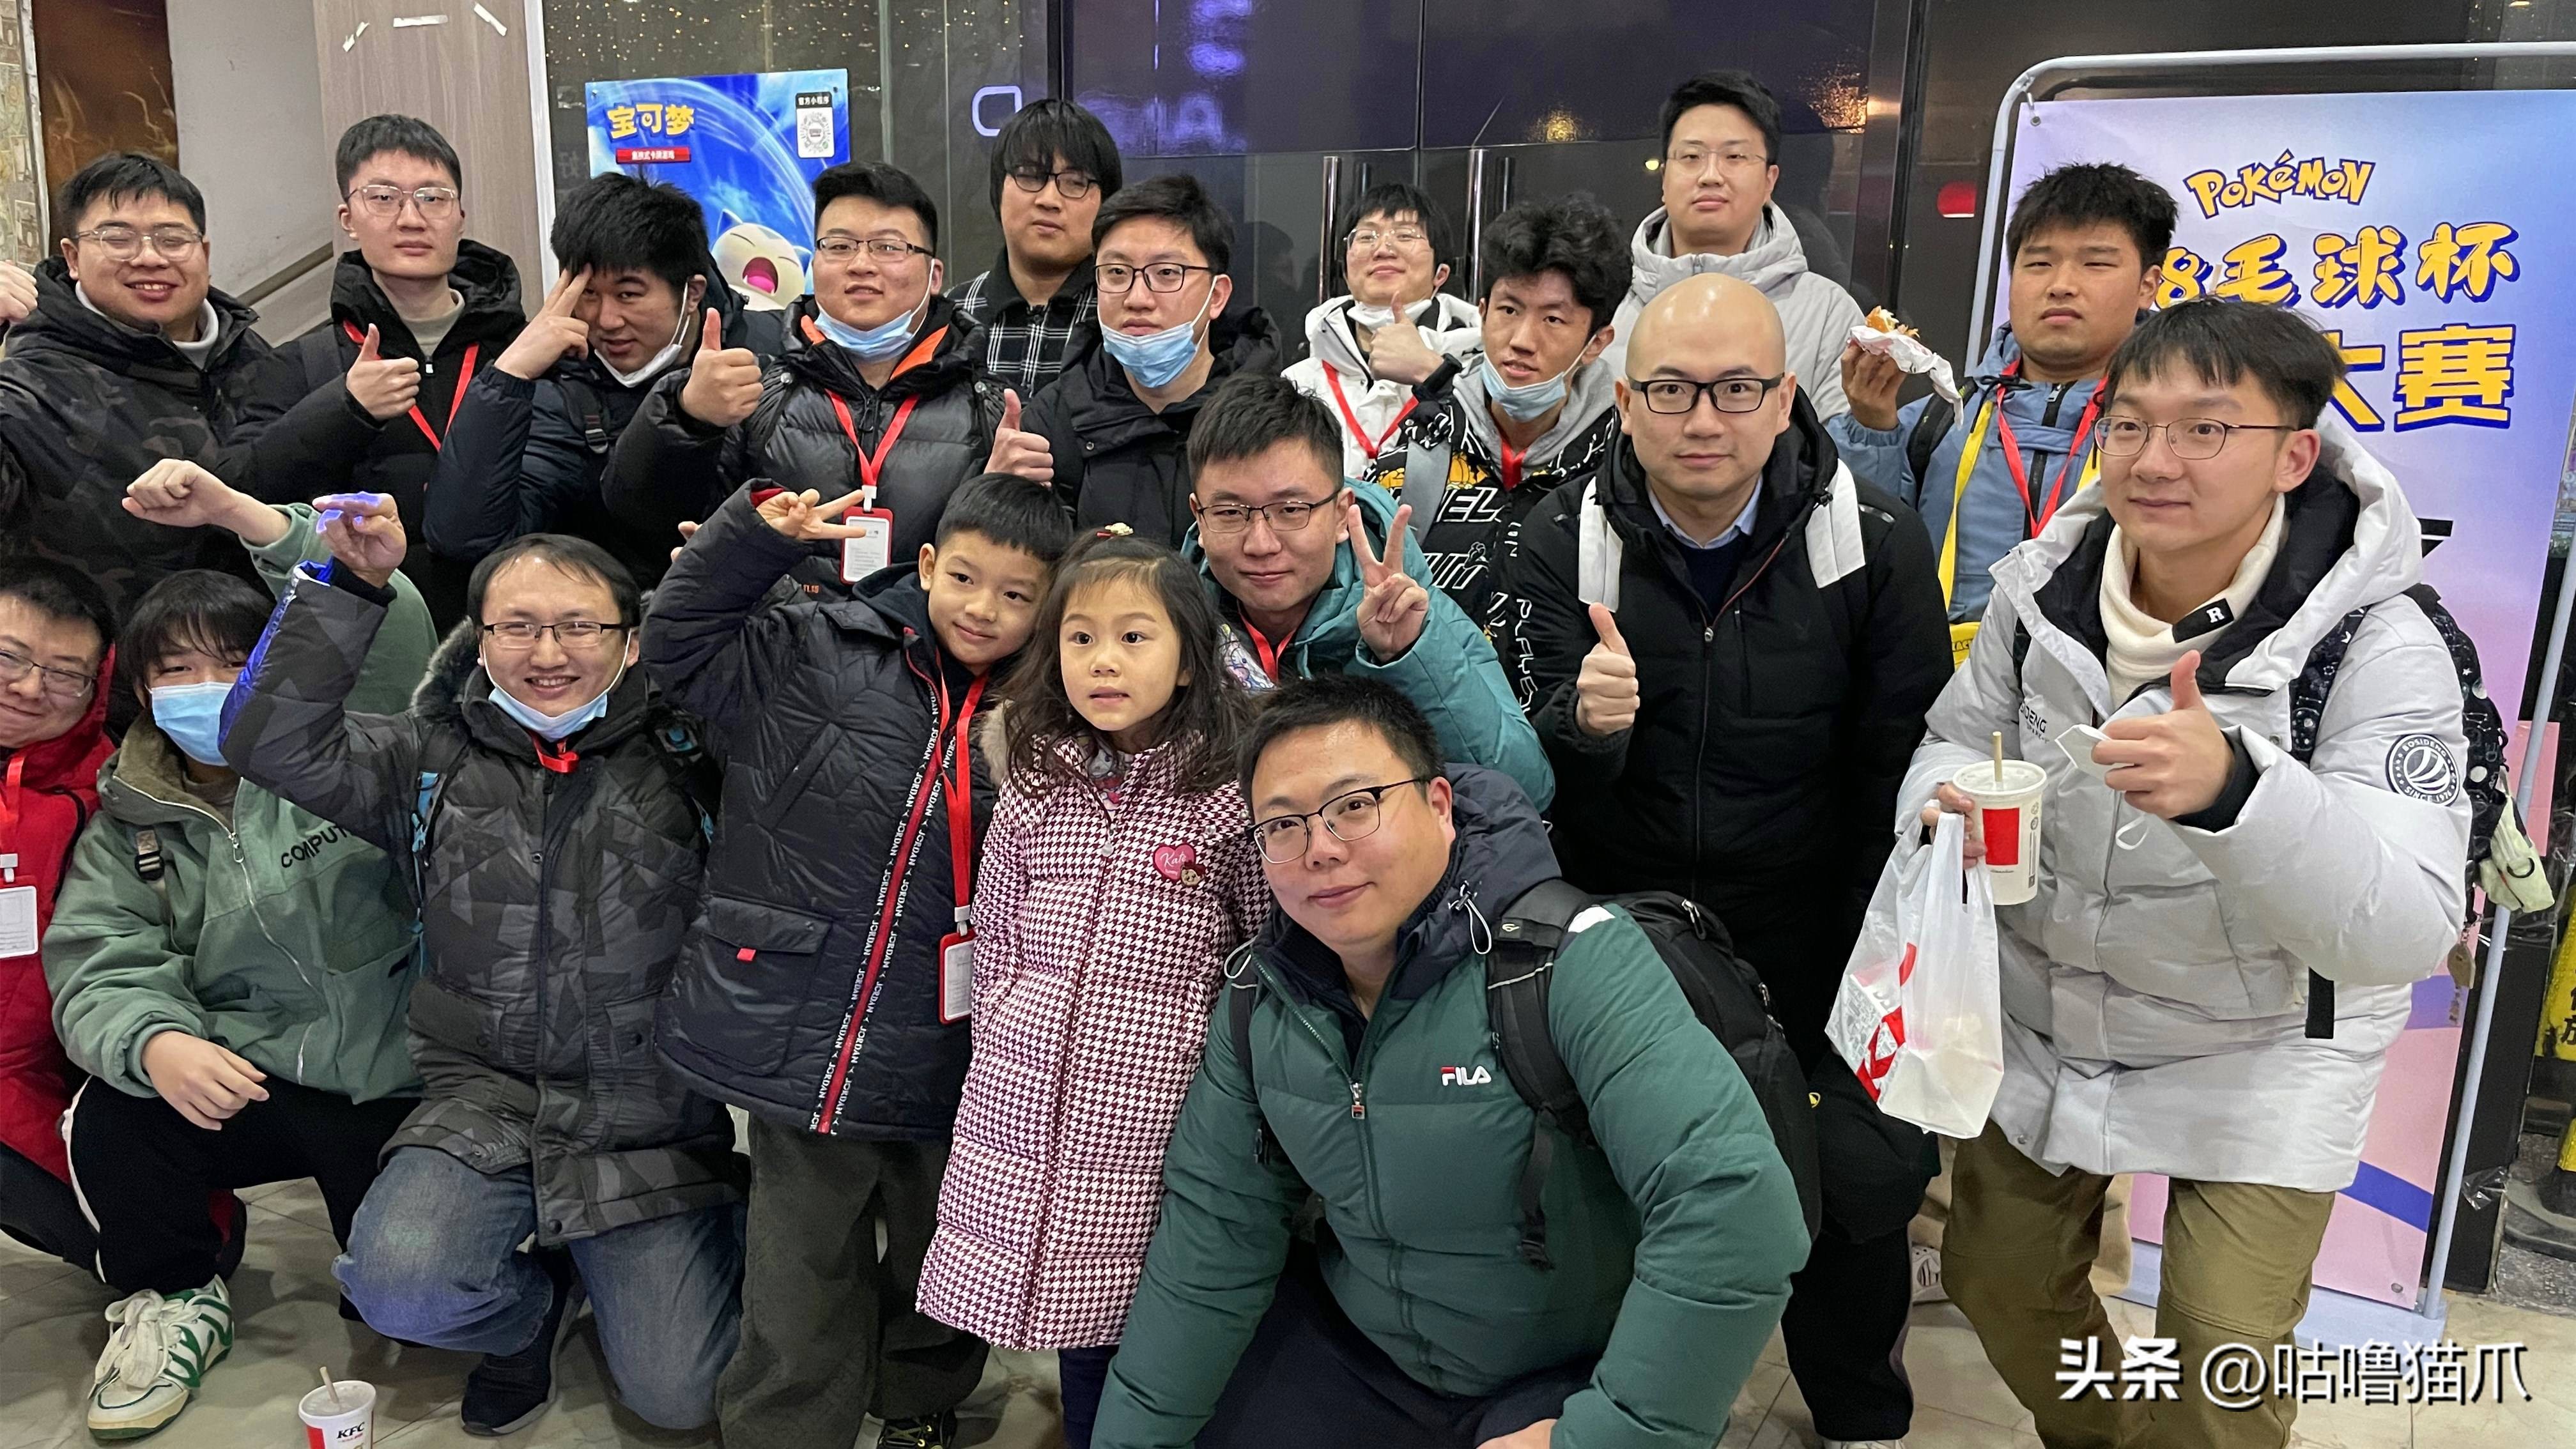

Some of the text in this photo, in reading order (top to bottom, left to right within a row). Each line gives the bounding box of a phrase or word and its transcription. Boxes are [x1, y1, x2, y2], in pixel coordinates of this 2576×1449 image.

[606, 102, 695, 141] 宝可梦
[2206, 607, 2225, 623] R
[2402, 738, 2447, 757] BOSIDENG
[906, 772, 923, 808] JORDAN
[925, 779, 942, 816] JORDAN
[2403, 786, 2433, 803] SINCE
[889, 820, 907, 857] JORDAN
[908, 829, 926, 866] JORDAN
[876, 869, 891, 906] JORDAN
[895, 878, 910, 917] JORDAN
[863, 920, 879, 956] JORDAN
[883, 931, 898, 969] JORDAN
[835, 1013, 852, 1048] JORDAN
[851, 1025, 867, 1064] JORDAN
[819, 1062, 836, 1098] JORDAN
[1440, 1065, 1492, 1086] FILA
[835, 1077, 852, 1115] JORDAN
[336, 1421, 365, 1439] KFC
